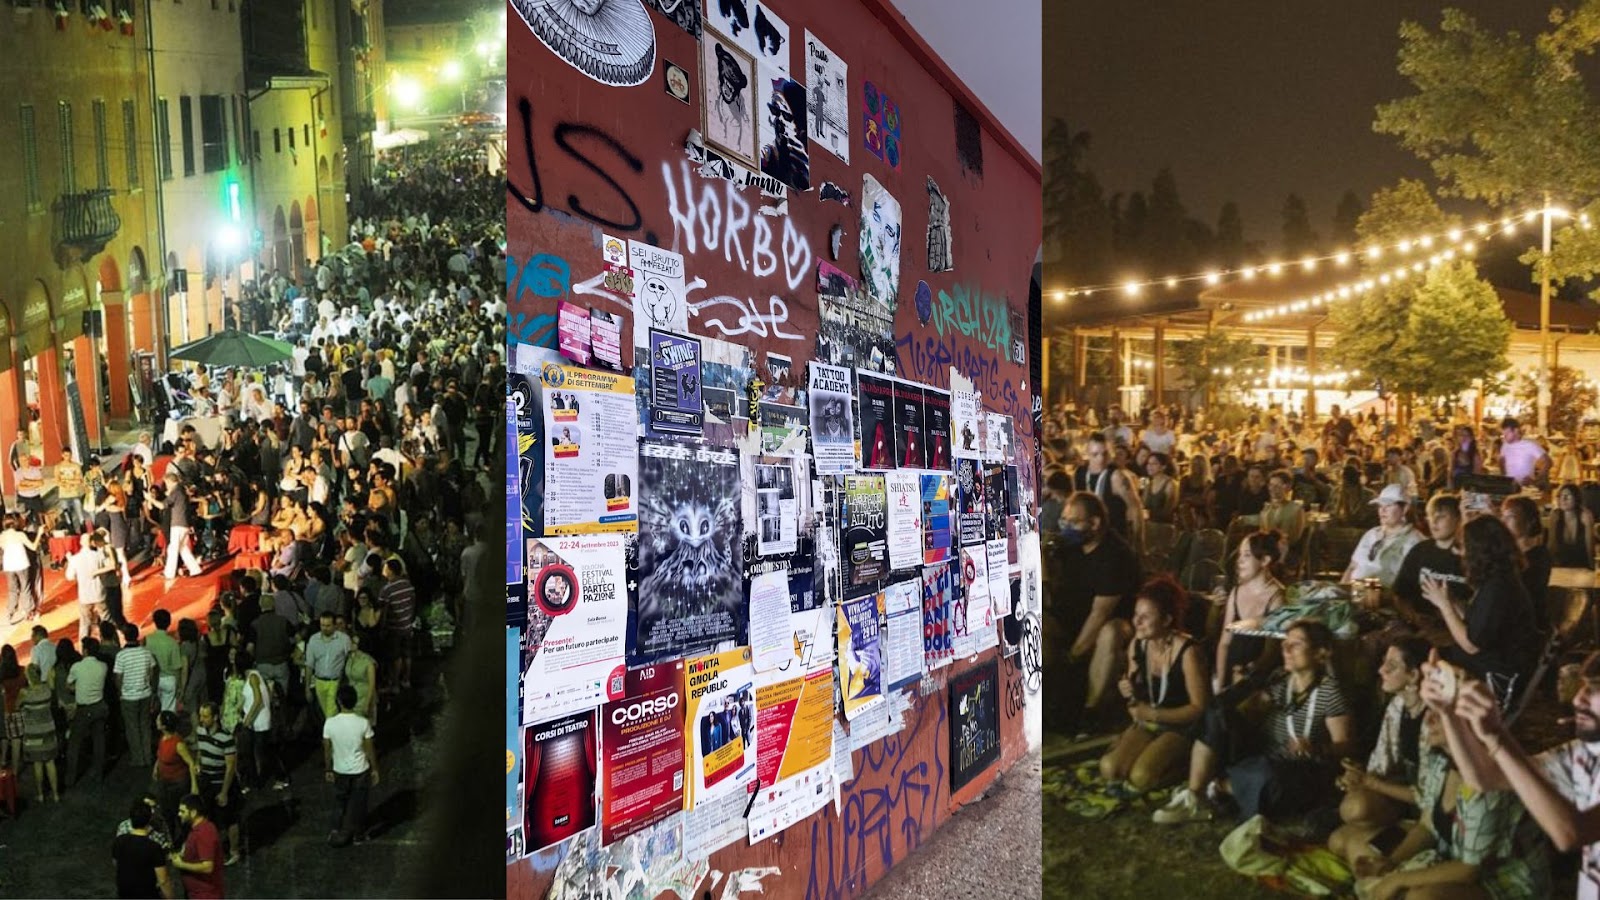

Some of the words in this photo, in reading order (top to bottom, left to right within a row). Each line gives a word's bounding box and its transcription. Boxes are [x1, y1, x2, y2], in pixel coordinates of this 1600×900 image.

[631, 247, 646, 258] SEI
[652, 252, 680, 268] BRUTTO
[662, 342, 694, 366] SWING
[816, 366, 844, 382] TATTOO
[576, 380, 613, 390] SETTEMBRE
[813, 378, 849, 394] ACADEMY
[890, 482, 916, 492] SHIATSU
[560, 542, 580, 550] 22-24
[582, 569, 614, 578] FESTIVAL
[582, 577, 606, 586] DELLA
[583, 583, 615, 594] PARTECI
[584, 592, 616, 603] PAZIONE
[544, 636, 574, 647] Presente!
[544, 646, 554, 654] Per
[566, 642, 586, 650] futuro
[586, 636, 618, 647] partecipato
[692, 680, 728, 700] REPUBLIC
[612, 692, 678, 724] CORSO
[535, 729, 556, 742] CORSI
[557, 726, 564, 736] DI
[565, 720, 588, 734] TEATRO
